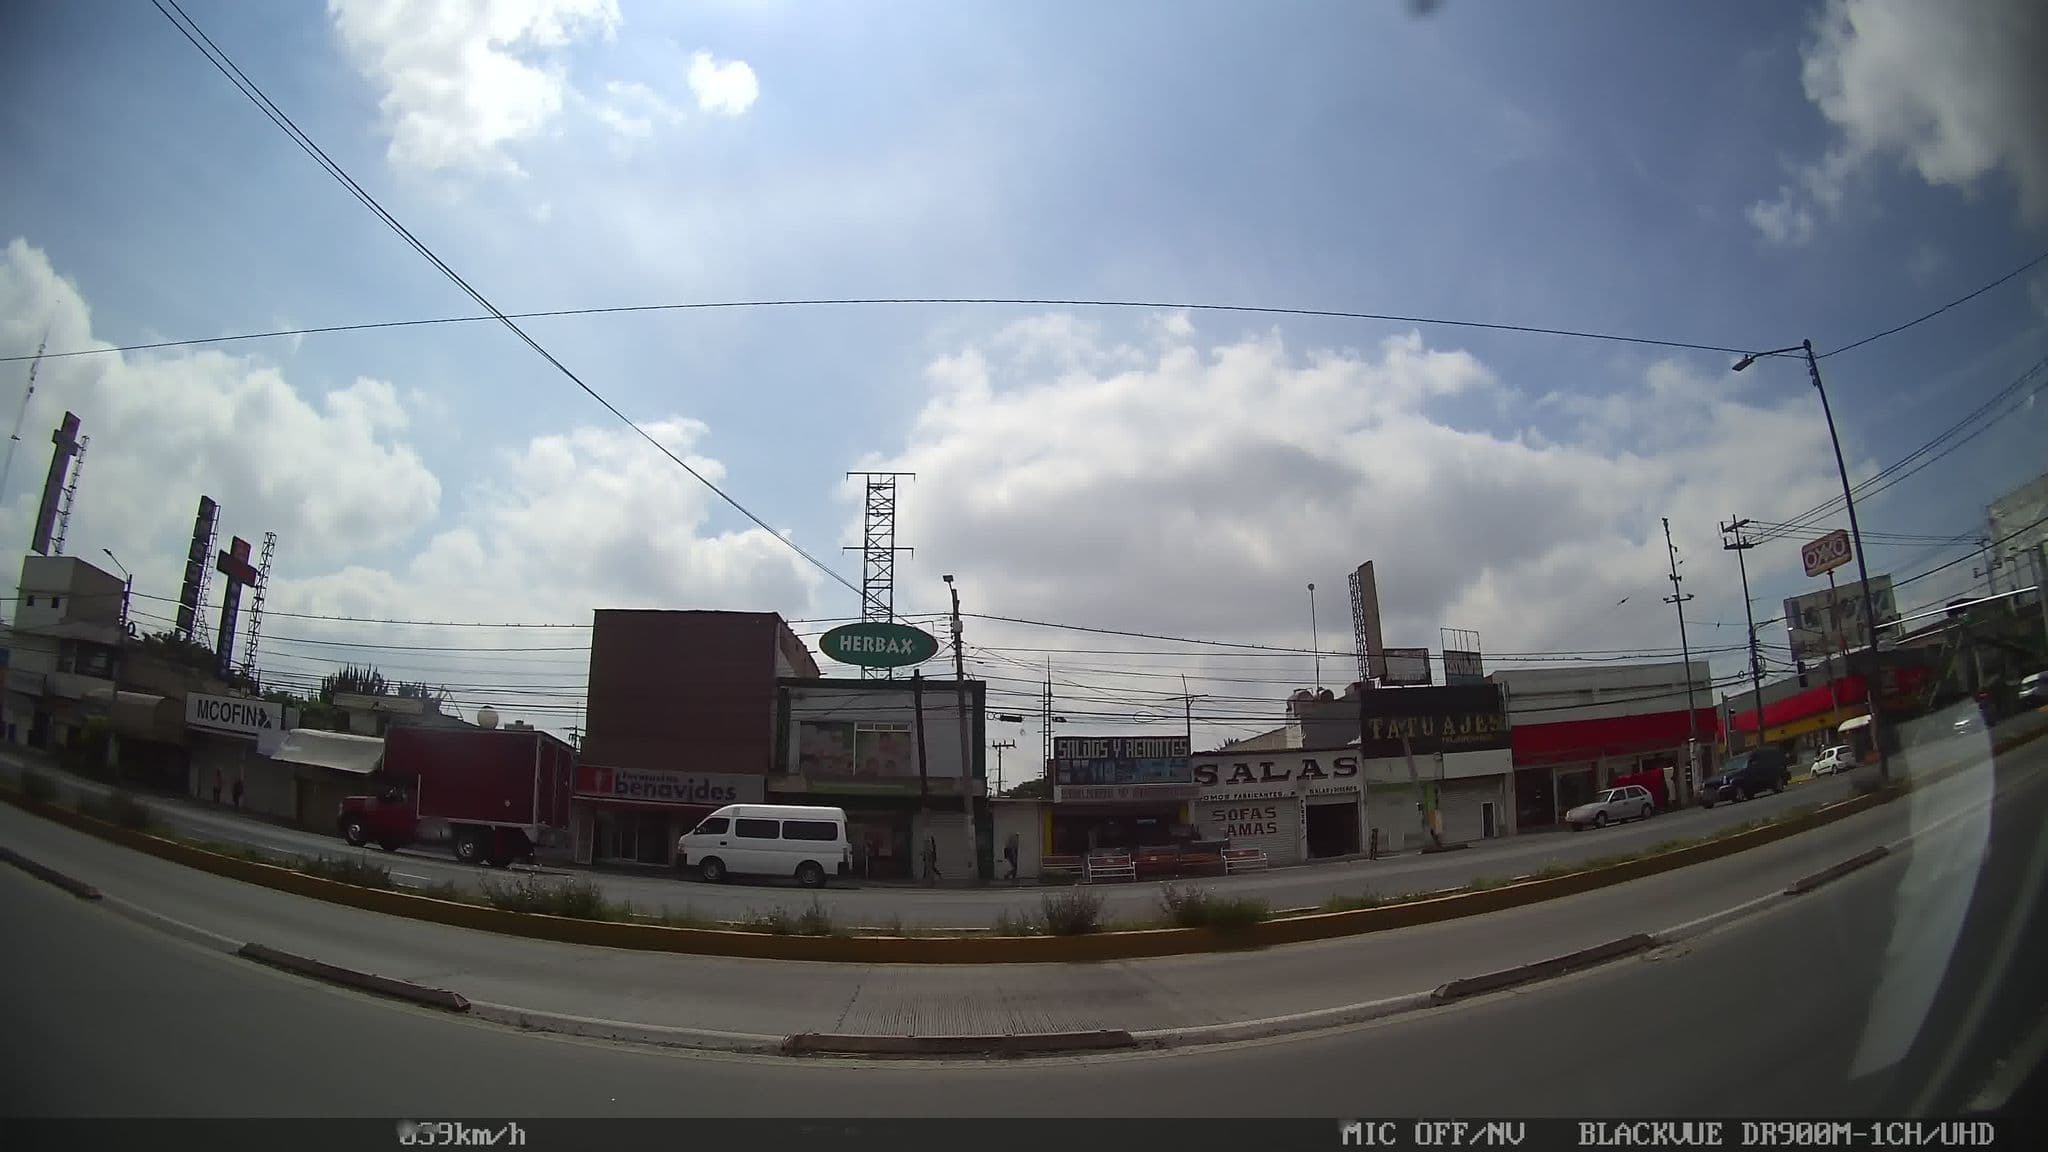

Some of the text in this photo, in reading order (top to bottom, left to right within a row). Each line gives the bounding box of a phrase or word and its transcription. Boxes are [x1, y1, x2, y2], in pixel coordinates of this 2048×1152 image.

[1804, 537, 1846, 569] OXXO
[839, 634, 913, 656] HERBAX
[1369, 713, 1503, 740] TATUAJES
[1112, 739, 1122, 758] Y
[1193, 756, 1358, 787] SALAS
[615, 772, 737, 801] benavides
[1212, 806, 1277, 822] SOFAS
